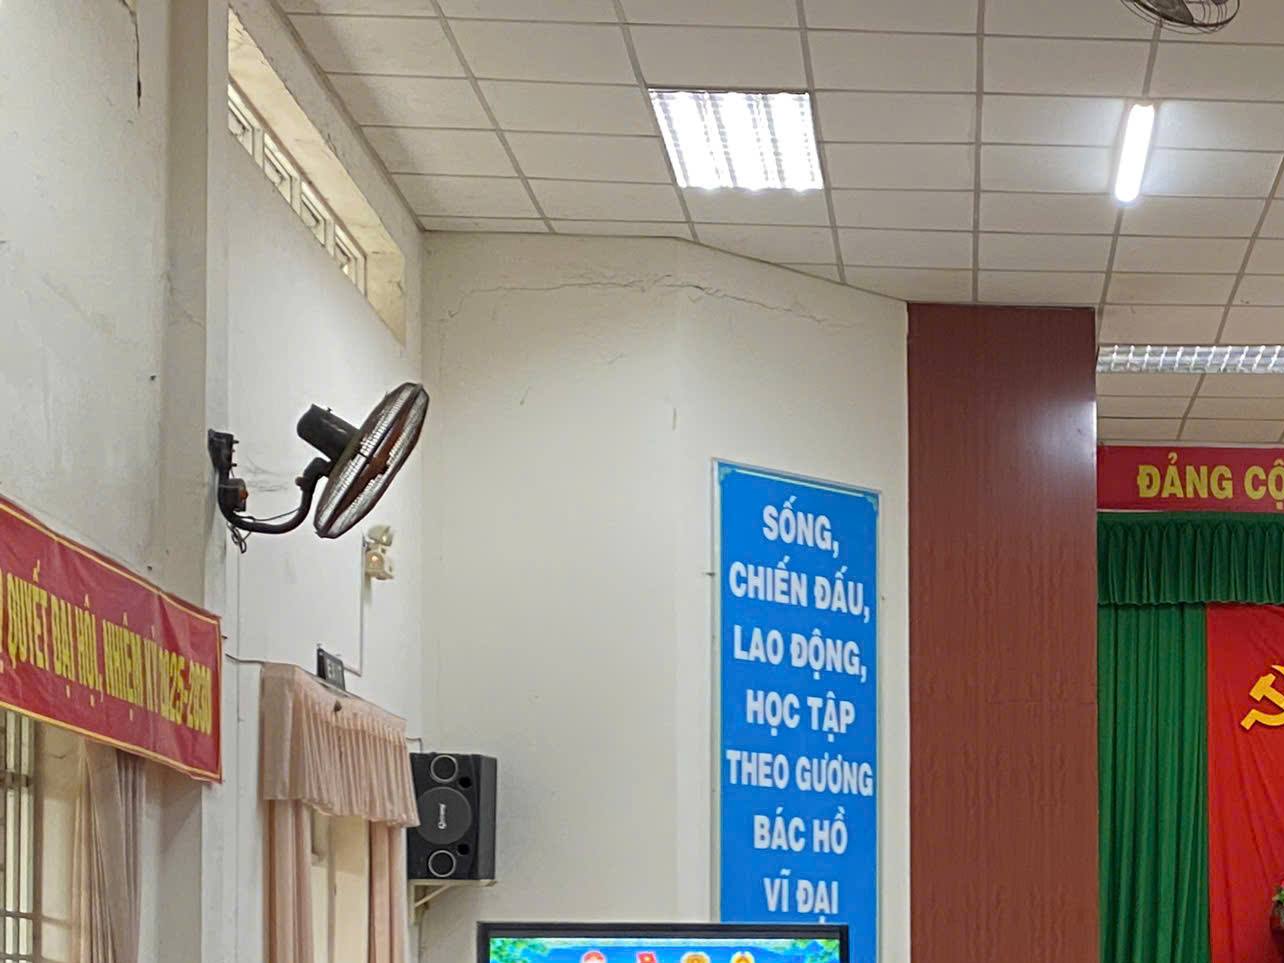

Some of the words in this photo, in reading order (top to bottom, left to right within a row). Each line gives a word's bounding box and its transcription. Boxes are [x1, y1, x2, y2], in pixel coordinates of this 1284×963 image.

[1137, 452, 1233, 499] ĐẢNG
[762, 496, 839, 559] SỐNG,
[729, 555, 807, 607] CHIẾN
[814, 566, 870, 623] ĐẤU,
[734, 624, 784, 665] LAO
[790, 628, 867, 683] ĐỘNG,
[746, 689, 800, 736] HỌC
[807, 691, 855, 742] TẬP
[726, 749, 790, 789] THEO
[795, 752, 873, 796] GƯƠNG
[753, 807, 806, 852] BÁC
[813, 806, 848, 854] HỒ
[763, 868, 791, 912] VĨ
[796, 879, 839, 923] ĐẠI
